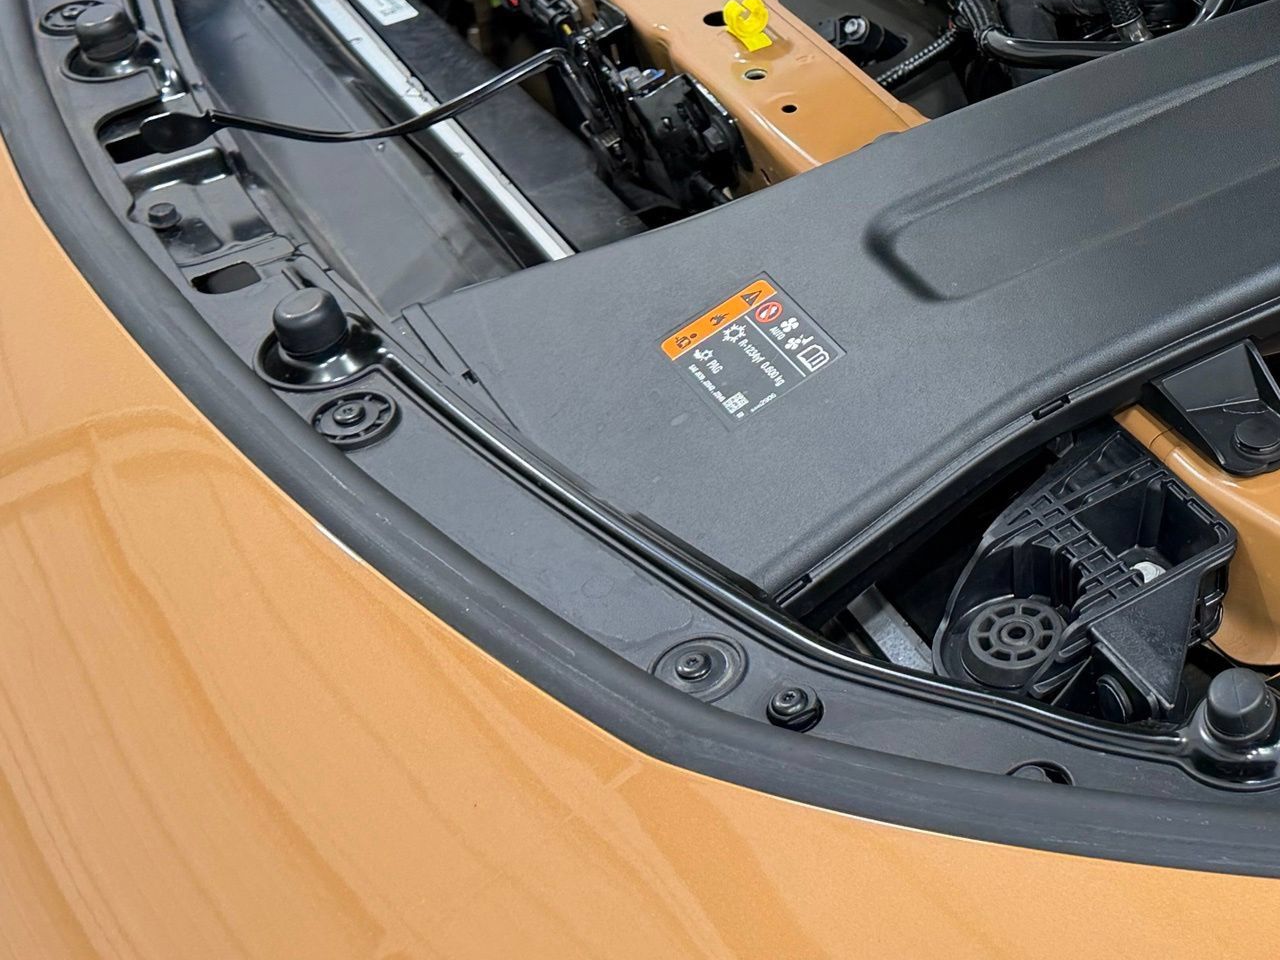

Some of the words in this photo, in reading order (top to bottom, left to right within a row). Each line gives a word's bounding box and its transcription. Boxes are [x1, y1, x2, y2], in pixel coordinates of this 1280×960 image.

[769, 326, 786, 340] AUTO
[706, 359, 723, 375] PAG
[774, 374, 785, 387] kg
